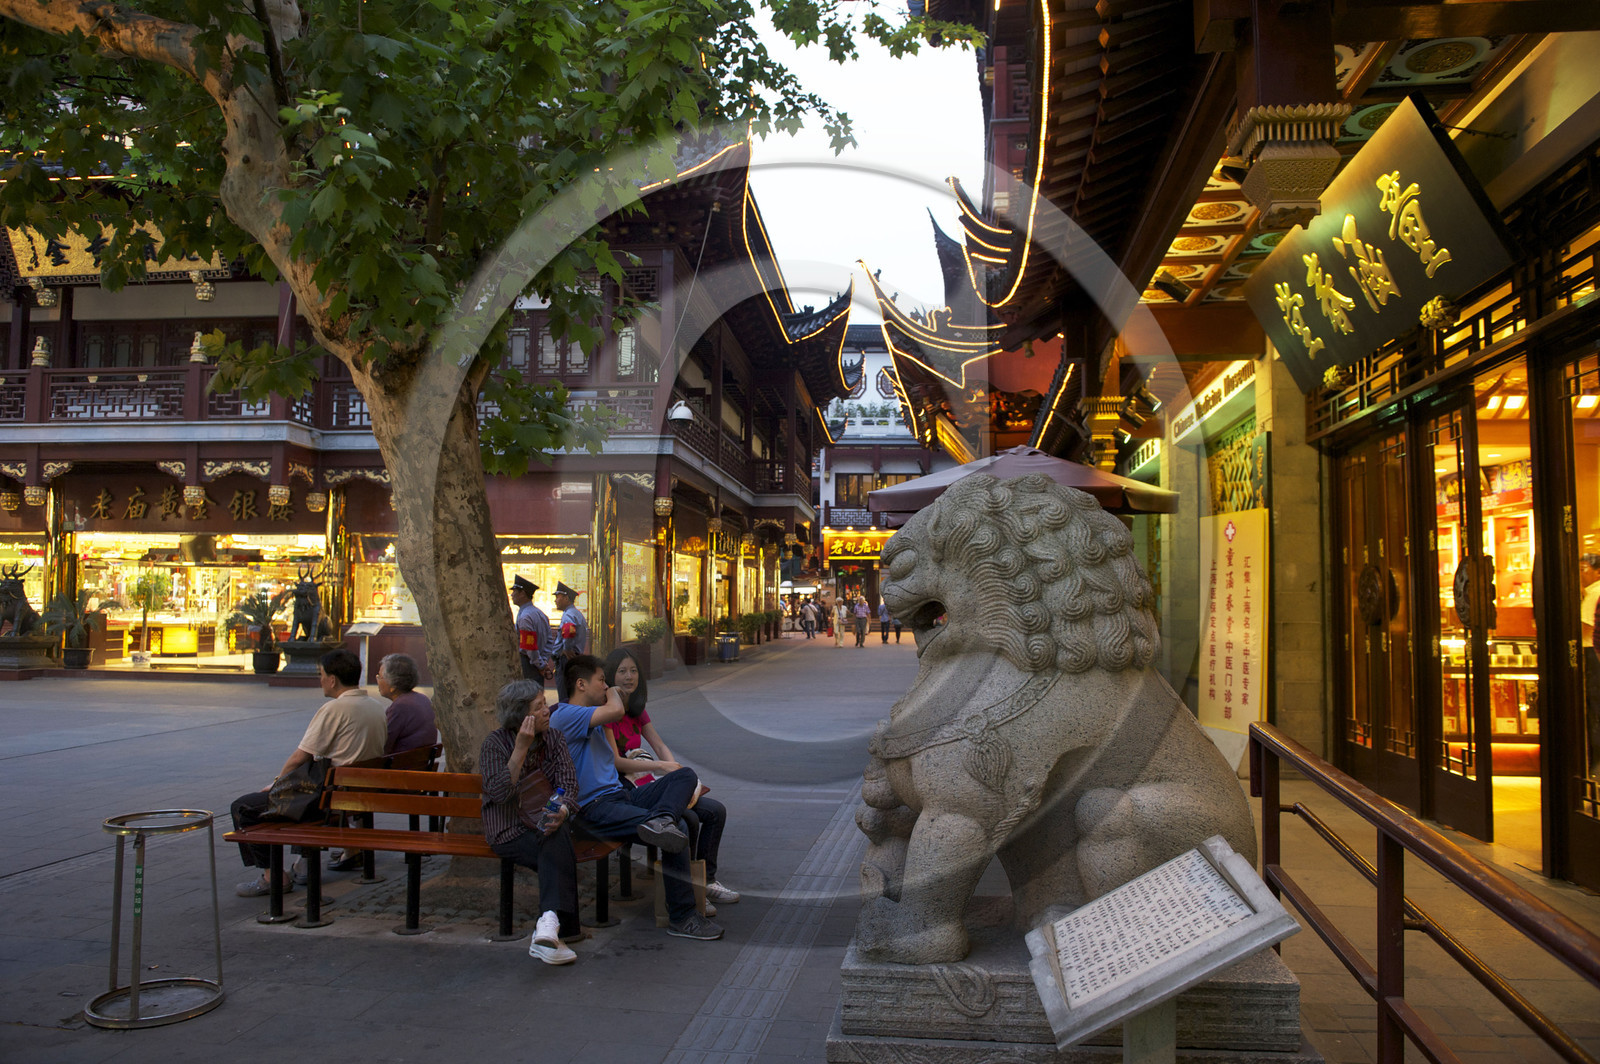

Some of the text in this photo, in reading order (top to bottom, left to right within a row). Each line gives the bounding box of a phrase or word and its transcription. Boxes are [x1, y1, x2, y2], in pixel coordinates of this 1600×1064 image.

[1173, 360, 1256, 438] Chinese Medicine Museum
[501, 545, 576, 556] Lao Miao Jewelry
